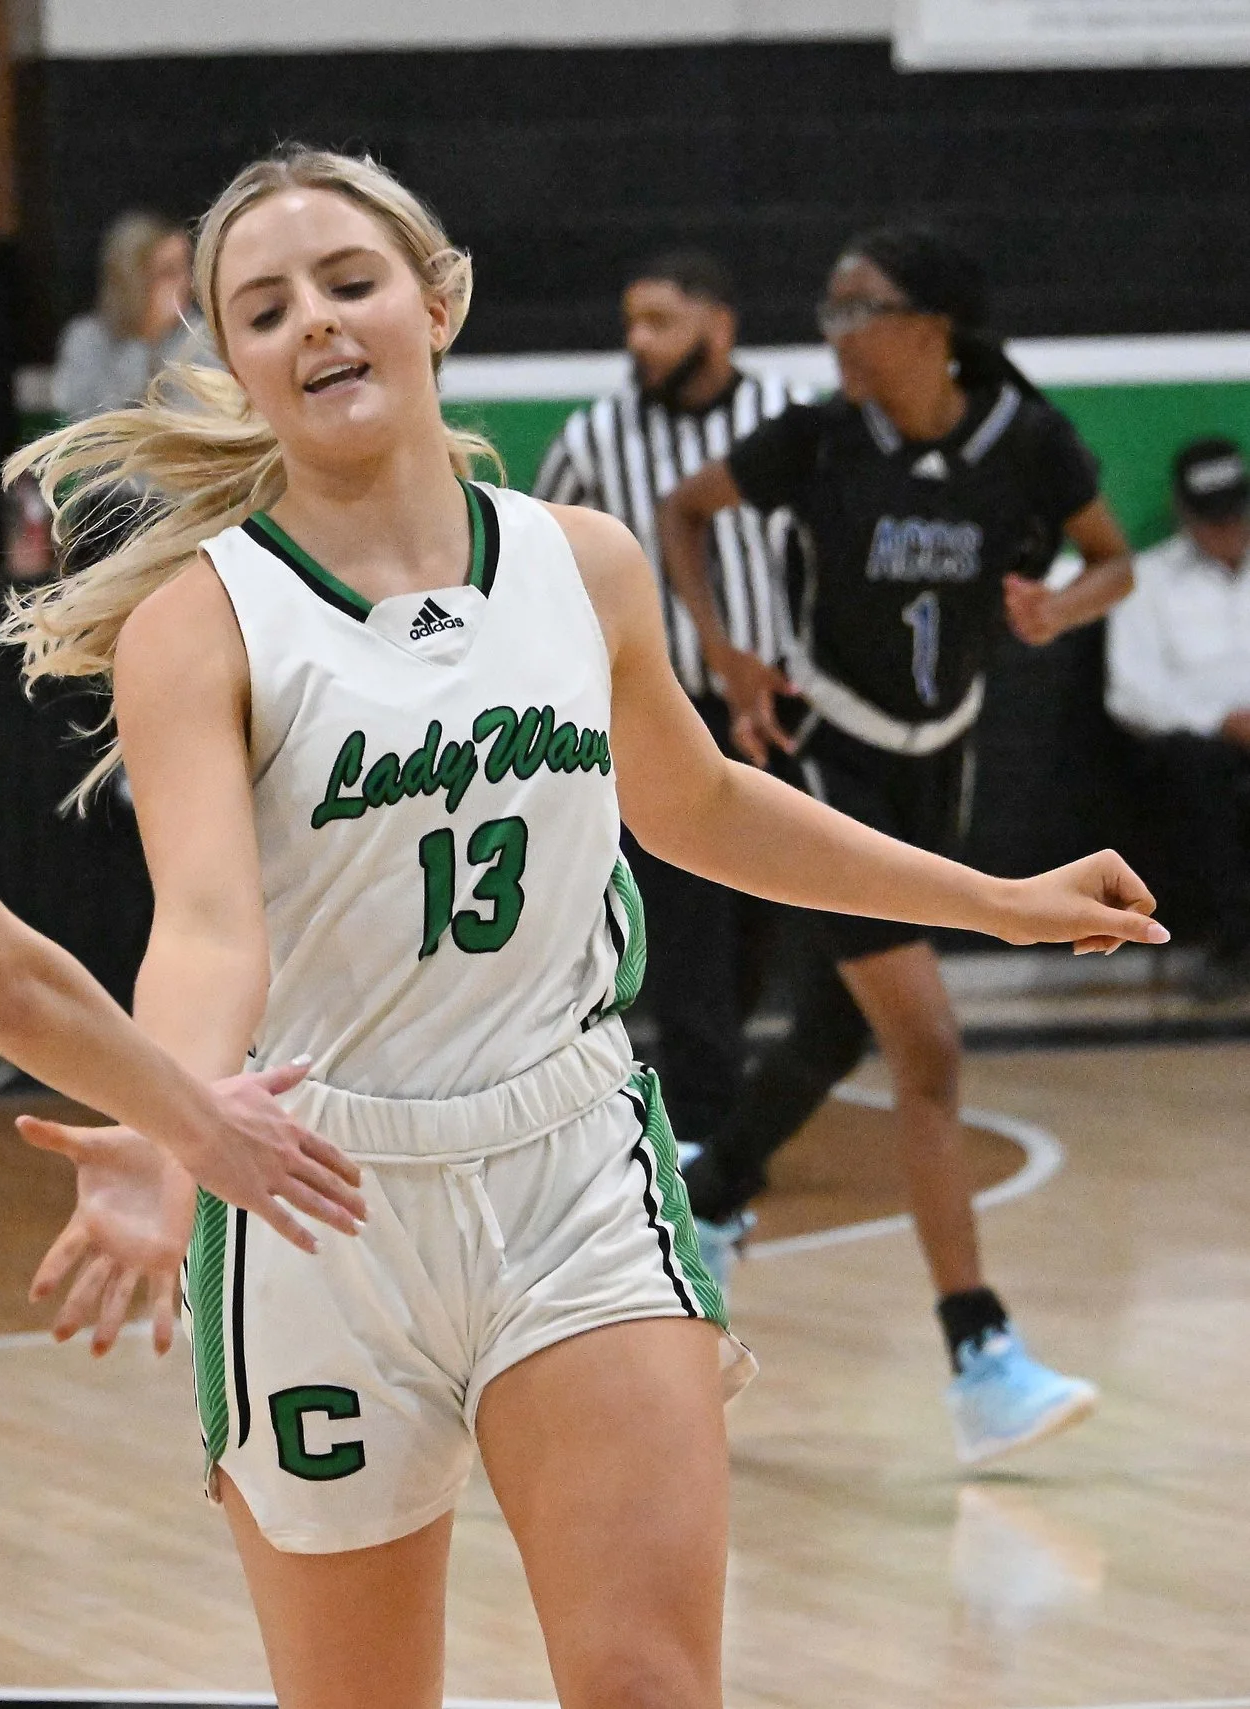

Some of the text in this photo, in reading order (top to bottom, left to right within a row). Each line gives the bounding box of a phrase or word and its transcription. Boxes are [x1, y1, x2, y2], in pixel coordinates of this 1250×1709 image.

[409, 617, 465, 641] adidas
[902, 592, 940, 706] 1
[310, 720, 479, 829] Lady
[418, 816, 529, 962] 13
[268, 1385, 366, 1481] C
